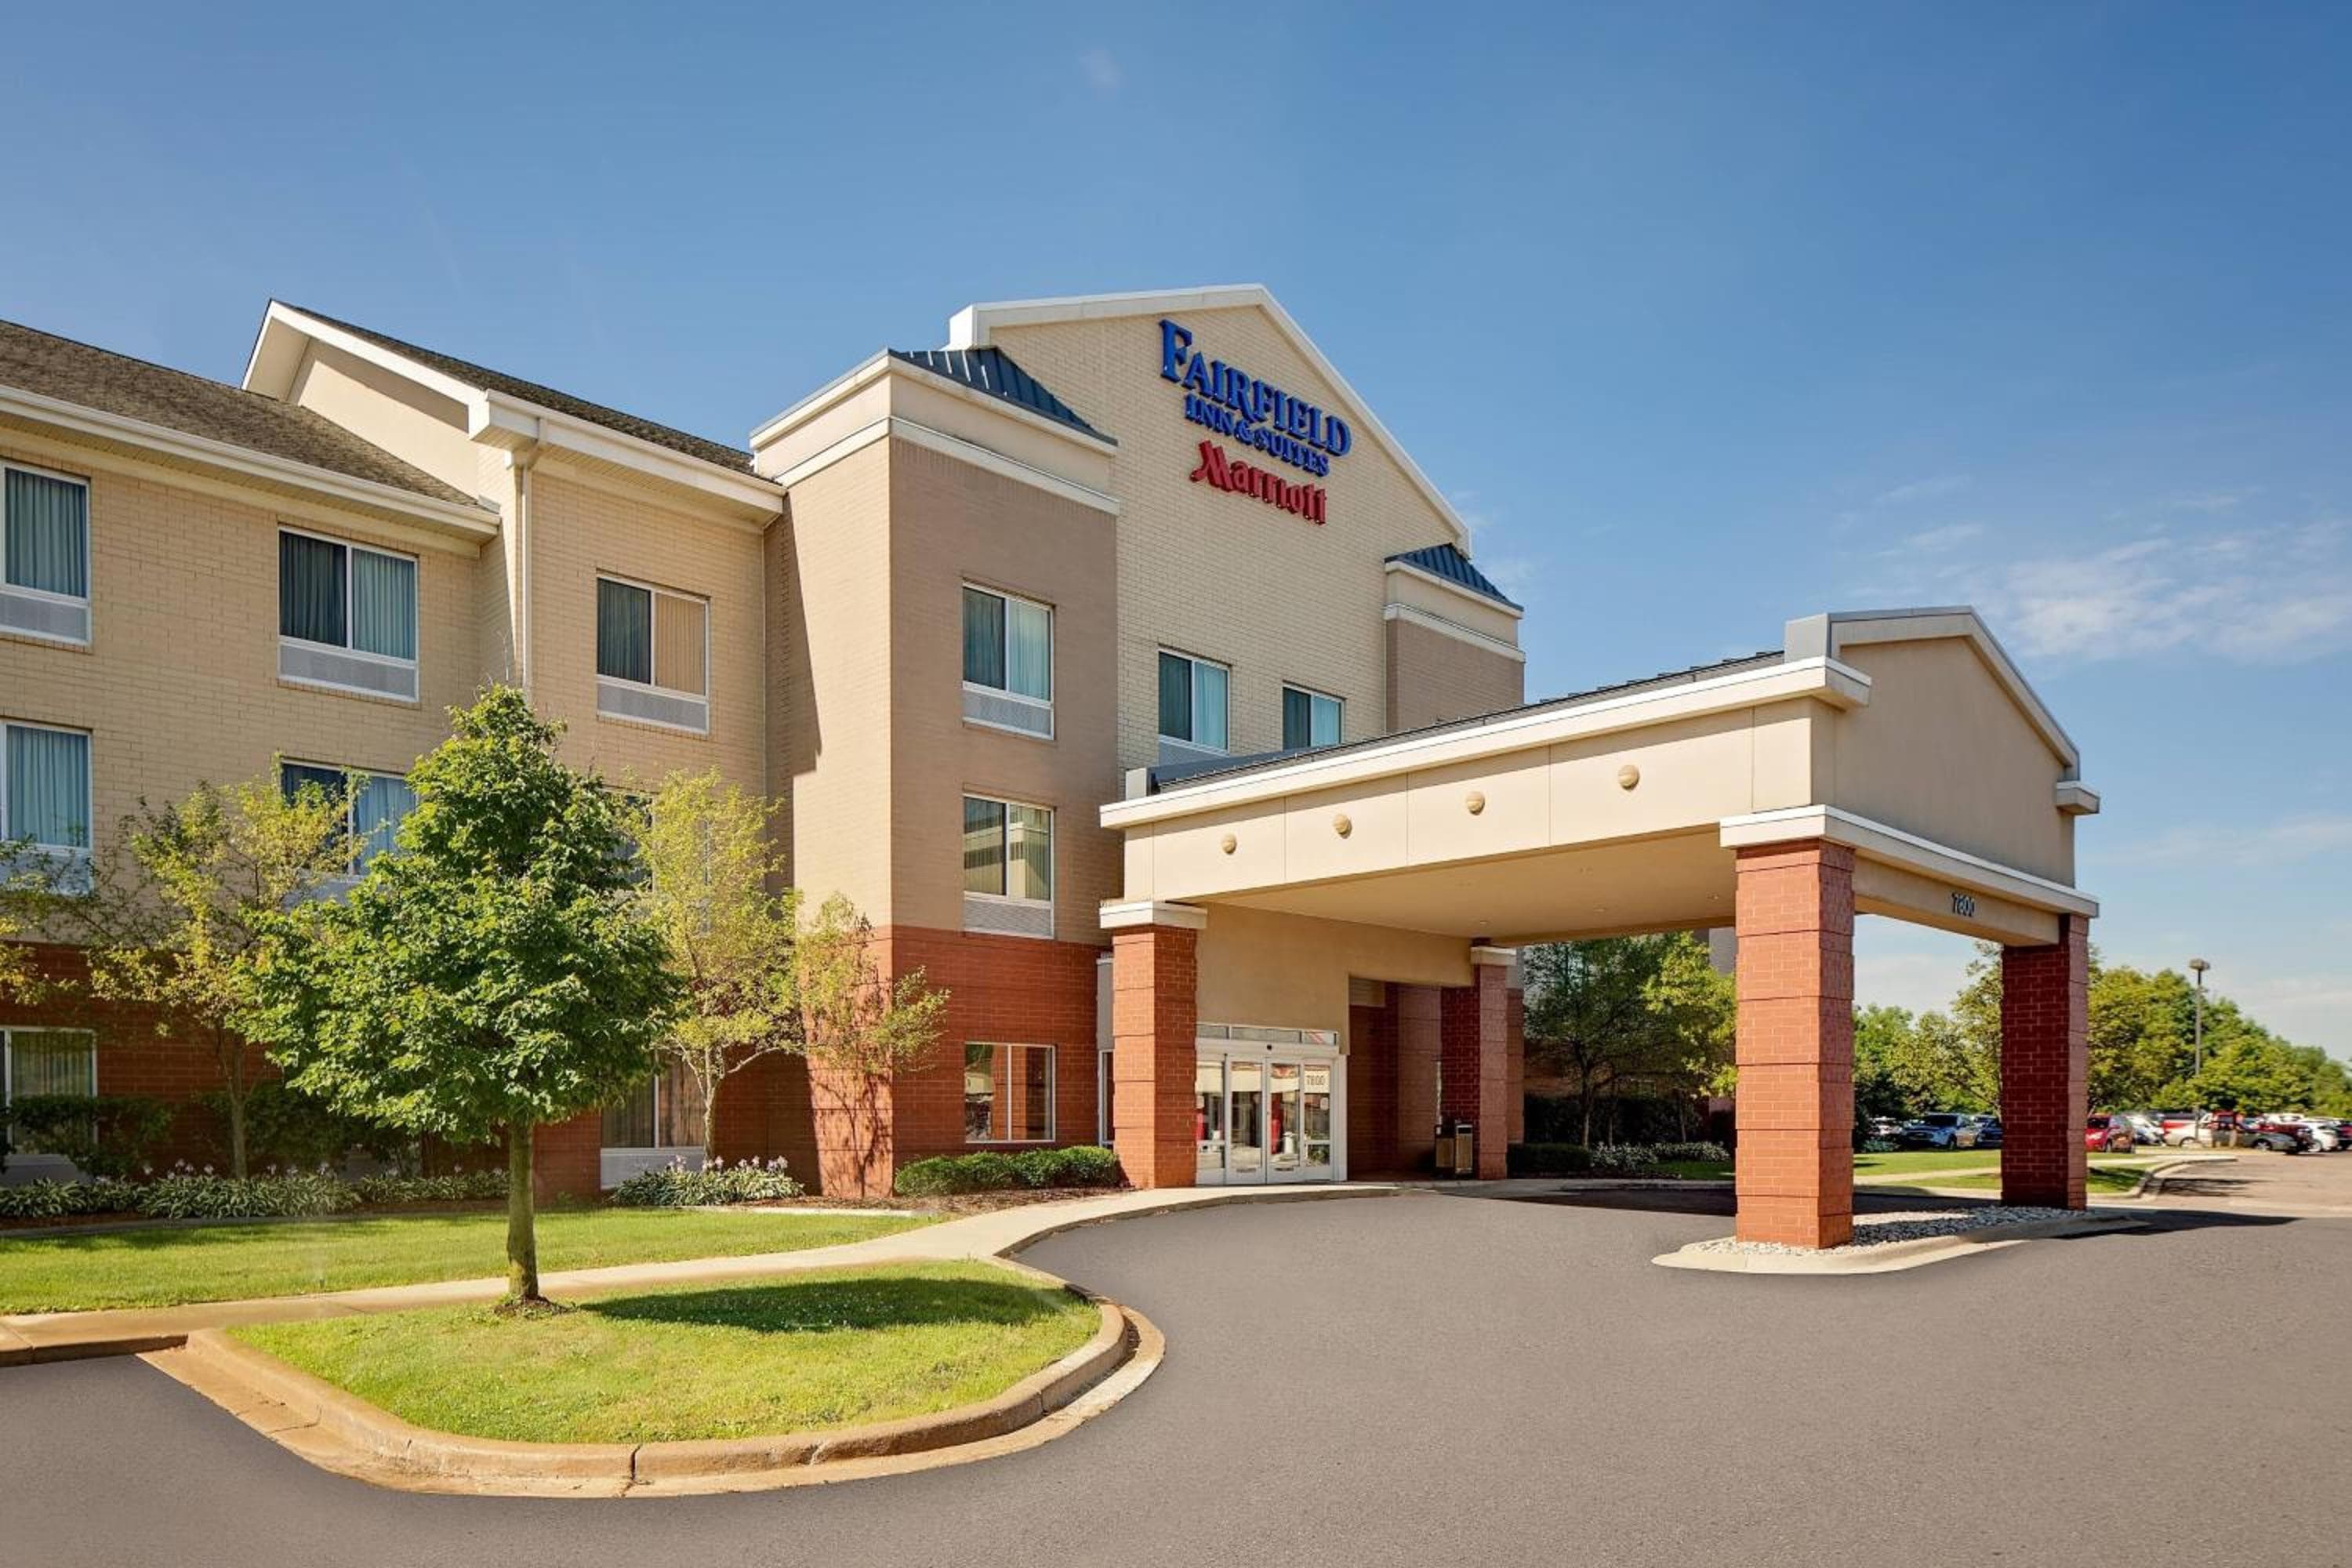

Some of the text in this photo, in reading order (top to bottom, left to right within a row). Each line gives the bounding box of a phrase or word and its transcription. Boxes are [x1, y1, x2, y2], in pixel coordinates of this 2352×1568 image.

[1158, 318, 1352, 456] FAIRFIELD
[1185, 393, 1236, 436] INN
[1254, 426, 1330, 477] SUITES
[1189, 439, 1327, 525] Marriott
